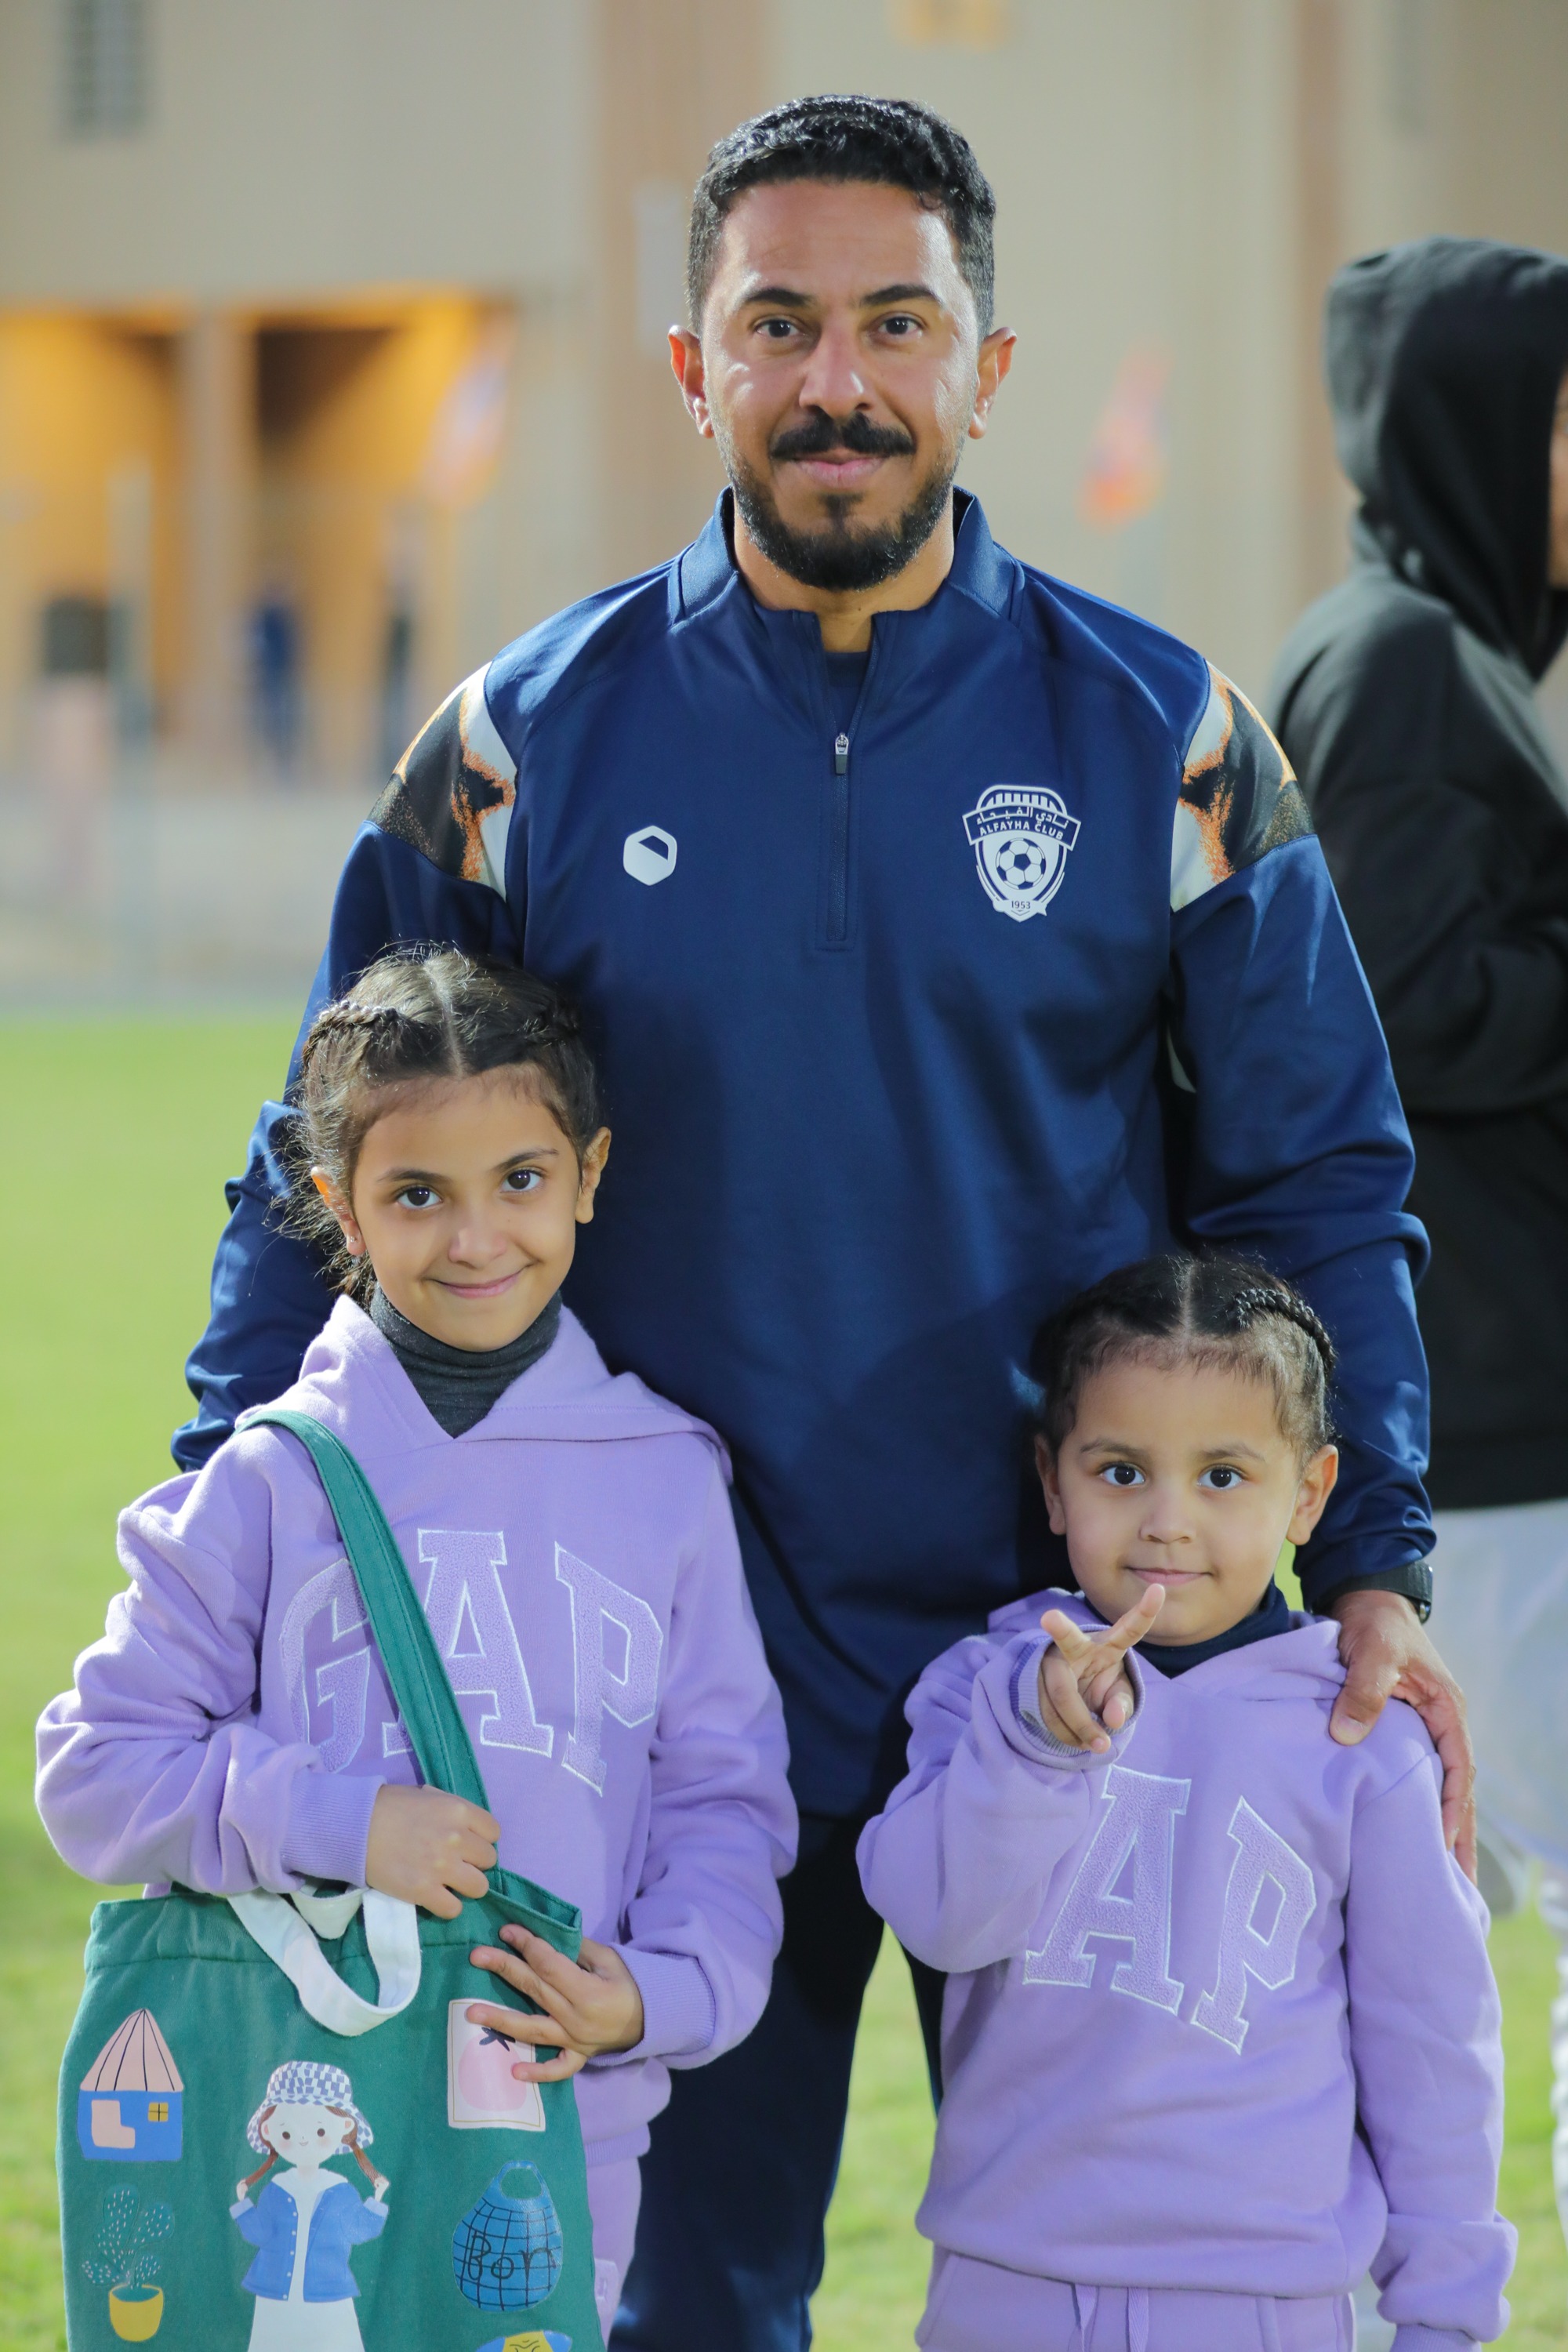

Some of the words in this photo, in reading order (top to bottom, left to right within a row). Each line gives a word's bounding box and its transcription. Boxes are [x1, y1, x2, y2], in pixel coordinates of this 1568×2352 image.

[979, 820, 1030, 837] ALFAYHA
[1034, 823, 1064, 840] CLUB
[1011, 901, 1031, 909] 1953
[278, 1528, 664, 1797] GAP
[1022, 1764, 1317, 2055] AP
